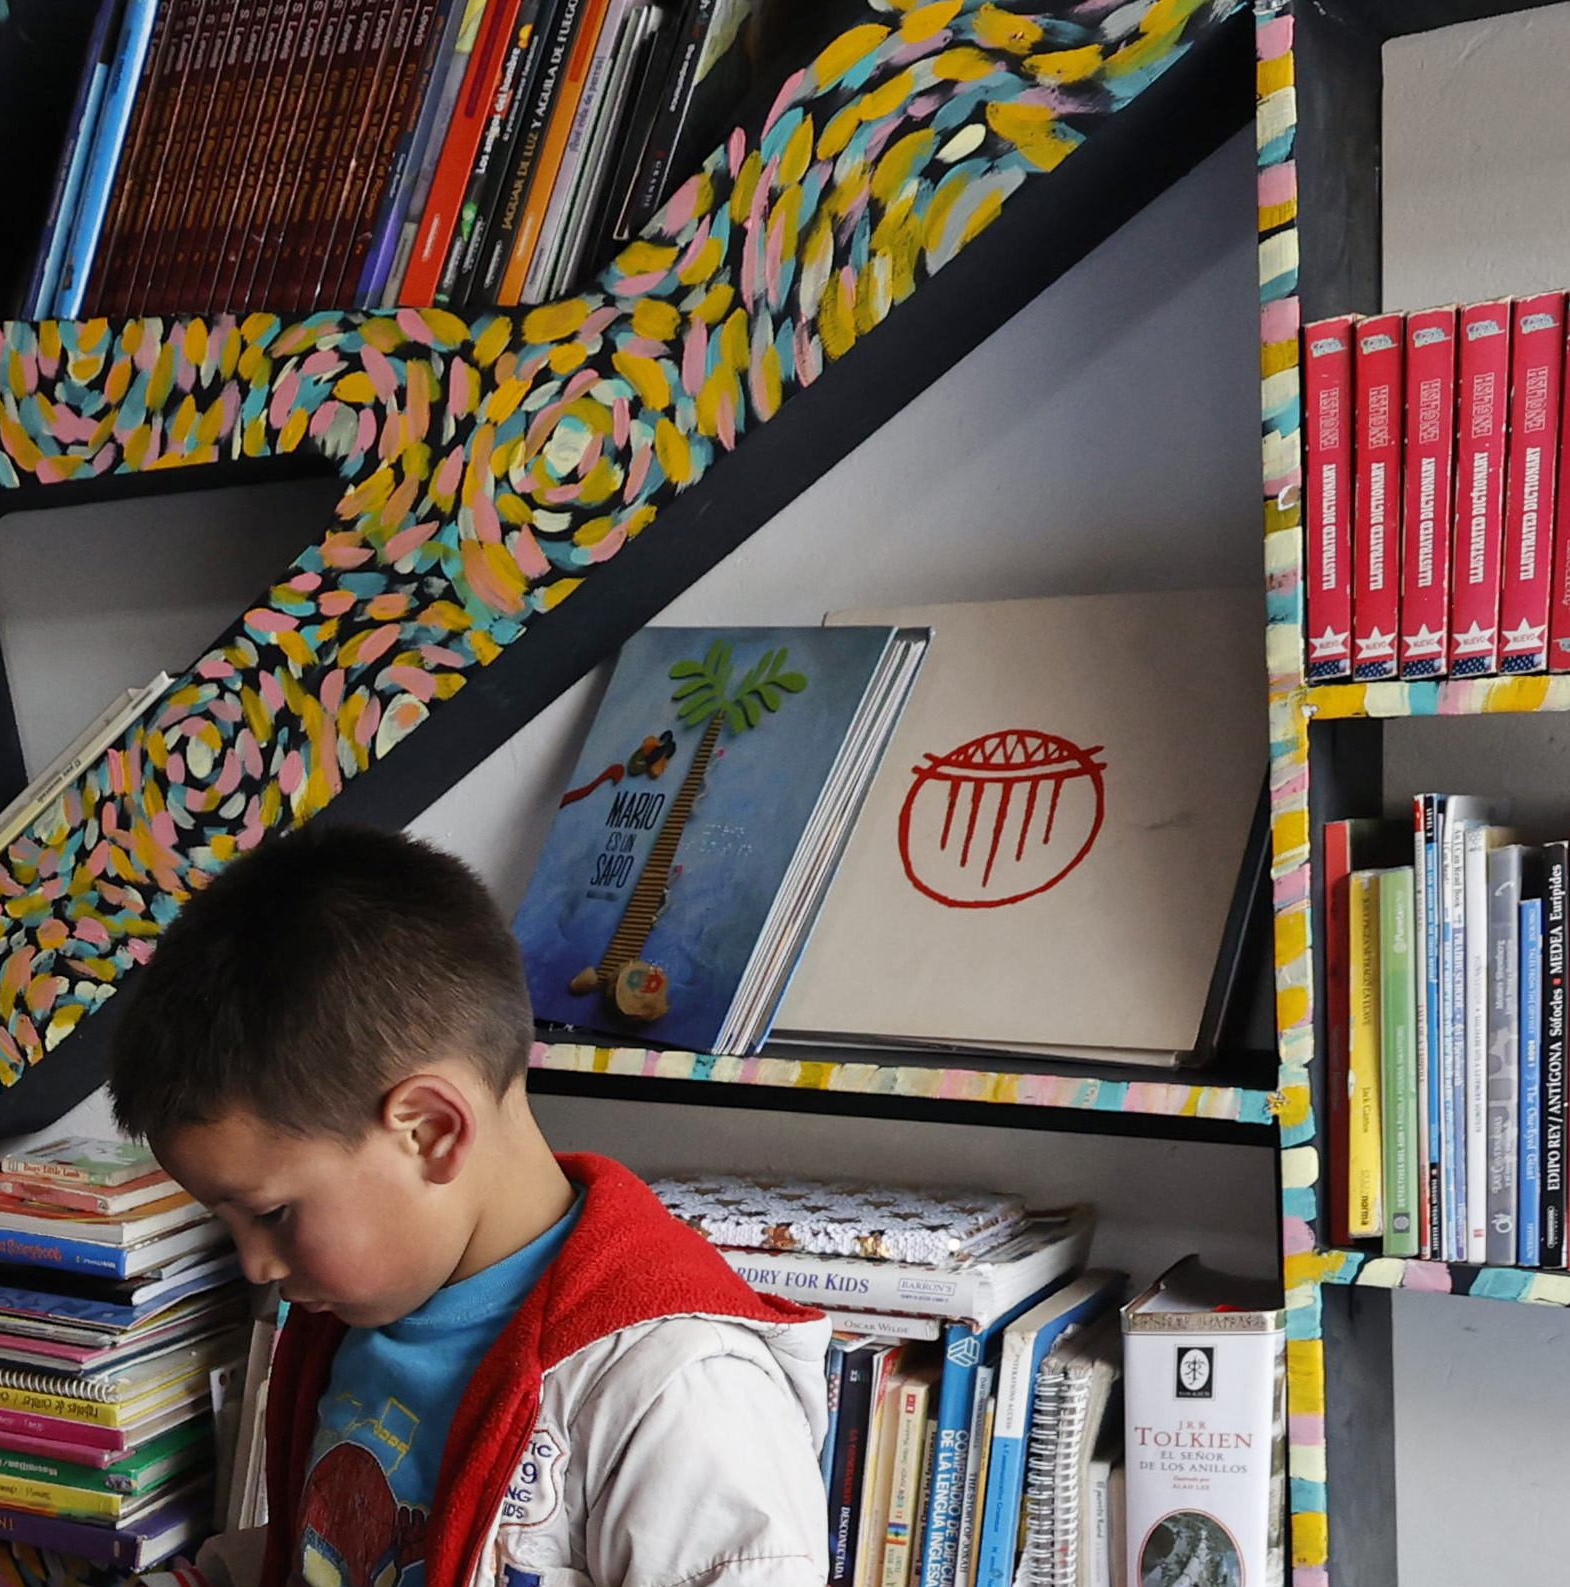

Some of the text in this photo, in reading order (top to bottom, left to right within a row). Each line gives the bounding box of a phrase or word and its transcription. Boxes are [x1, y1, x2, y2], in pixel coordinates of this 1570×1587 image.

[475, 47, 521, 175] Los amigos del hombre
[523, 130, 540, 159] LUZ
[1319, 387, 1340, 451] ENGLISH
[1368, 384, 1389, 449] ENGLISH
[1419, 378, 1441, 444] ENGLISH
[1472, 372, 1494, 438] ENGLISH
[1524, 365, 1548, 432] ENGLISH
[1322, 463, 1337, 590] ILLUSTRATED DICTIONARY
[1369, 462, 1386, 591] ILLUSTRATED DICTIONARY
[1418, 457, 1436, 588] ILLUSTRATED DICTIONARY
[1469, 452, 1489, 584] ILLUSTRATED DICTIONARY
[1520, 447, 1541, 580] ILLUSTRATED DICTIONARY
[606, 790, 666, 830] MARIO
[606, 832, 622, 852] ES
[590, 853, 634, 888] SAPO
[1454, 865, 1463, 886] Read
[1549, 863, 1565, 921] Eurípides
[1454, 889, 1463, 908] Book
[1551, 925, 1563, 974] MEDEA
[1550, 988, 1563, 1037] Sófocles
[1546, 1041, 1561, 1115] ANTÍGONA
[1524, 1084, 1537, 1181] The One-Eyed Giant
[1547, 1123, 1561, 1150] REY
[1547, 1151, 1561, 1191] EDIPO
[1360, 1195, 1370, 1227] norma
[784, 1270, 820, 1289] FOR
[824, 1272, 870, 1294] KIDS
[900, 1280, 953, 1293] BARRON'S
[843, 1318, 909, 1334] OSCAR WILDE
[936, 1451, 952, 1471] LA
[940, 1429, 955, 1449] DE
[1134, 1426, 1254, 1449] TOLKIEN
[1161, 1450, 1225, 1462] EL SEÑOR
[948, 1429, 970, 1517] COMPENDIO
[1139, 1461, 1248, 1473] DE LOS ANILLOS
[930, 1472, 950, 1529] LENGUA
[959, 1472, 977, 1574] THE STORY OF JONAH
[833, 1506, 851, 1580] DESCONECTADA
[944, 1519, 959, 1538] DE
